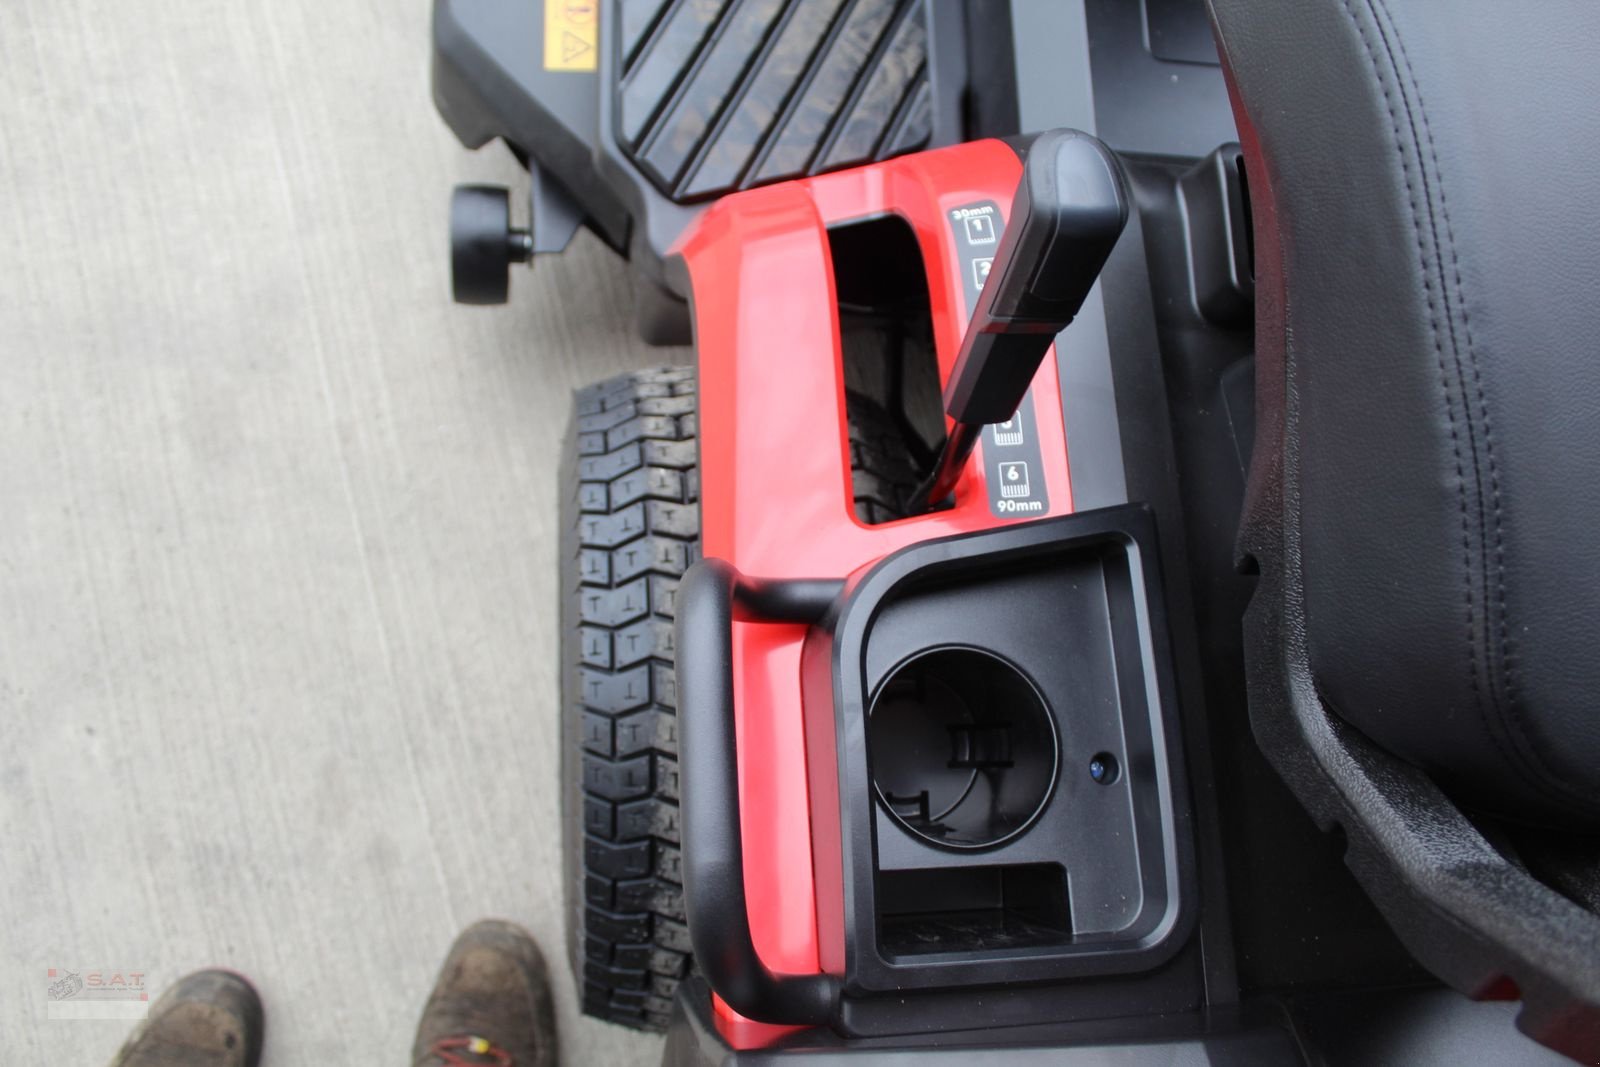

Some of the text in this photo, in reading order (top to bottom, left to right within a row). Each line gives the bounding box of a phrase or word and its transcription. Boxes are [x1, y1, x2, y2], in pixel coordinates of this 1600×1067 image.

[952, 206, 994, 220] 30mm
[972, 219, 983, 231] 1
[980, 261, 991, 275] 2
[1007, 466, 1019, 480] 6
[997, 500, 1042, 512] 90mm
